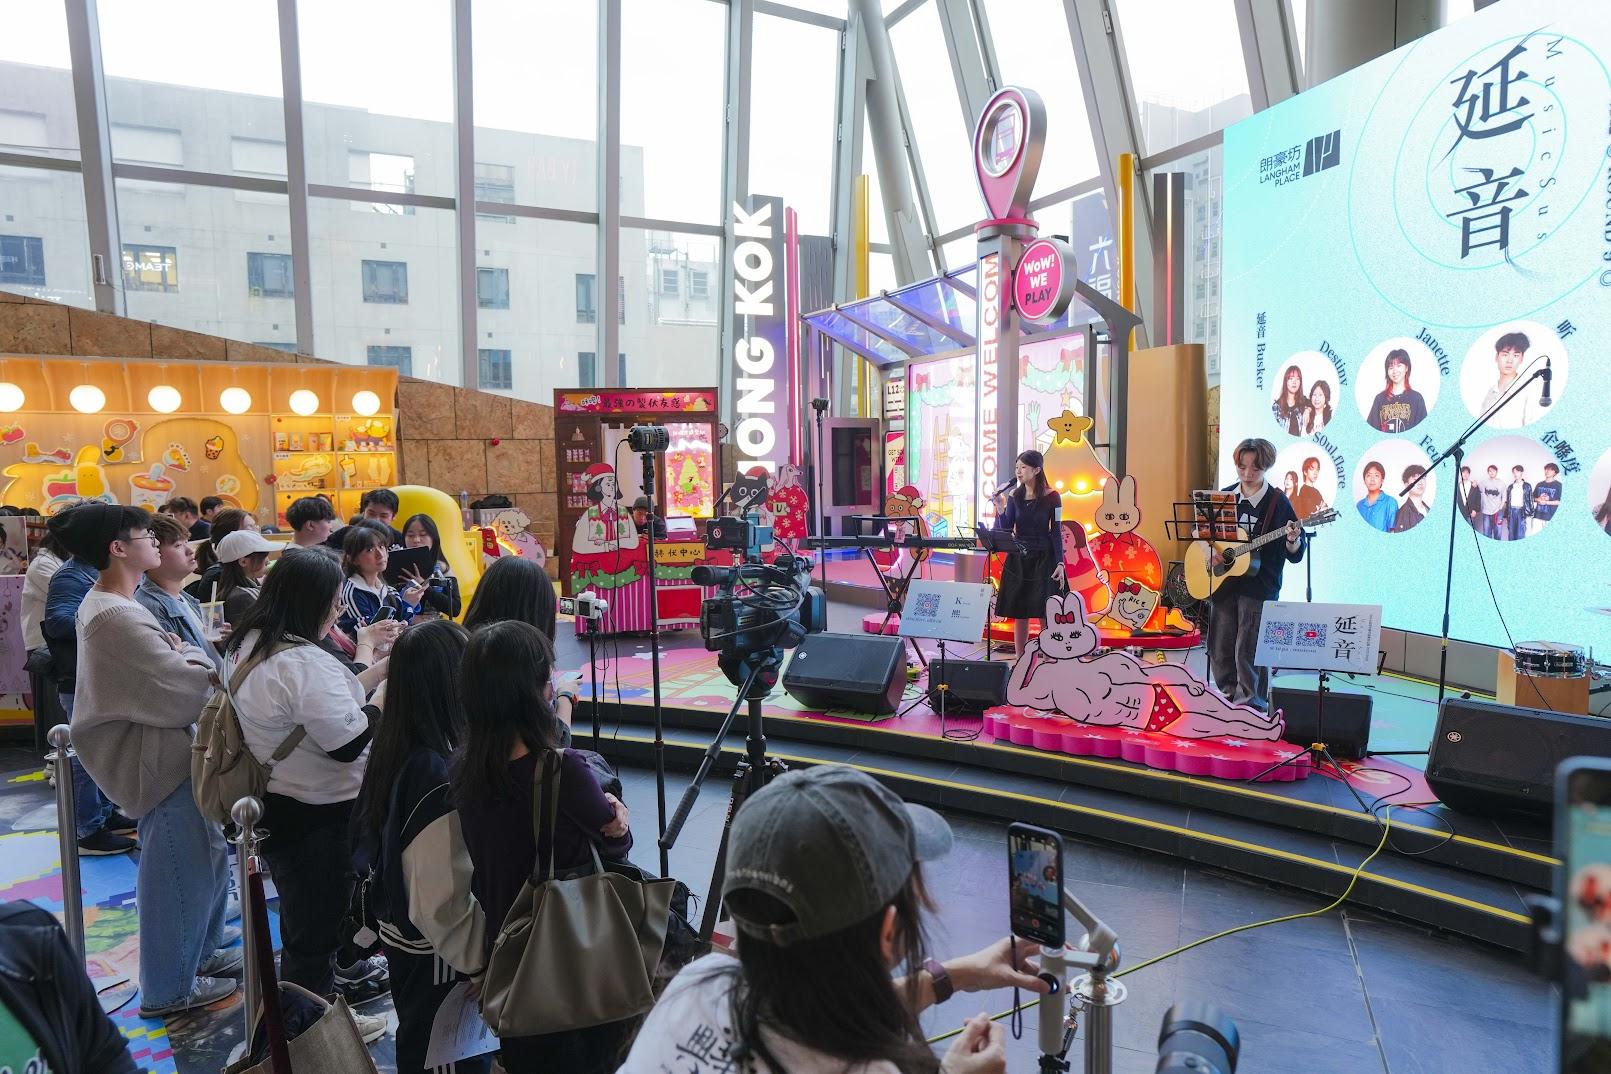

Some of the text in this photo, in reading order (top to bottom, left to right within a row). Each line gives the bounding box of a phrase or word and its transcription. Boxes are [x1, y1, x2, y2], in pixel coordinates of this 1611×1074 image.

[1259, 145, 1302, 173] 朗豪坊
[1437, 32, 1540, 264] 延音
[1259, 162, 1301, 184] LANGHAM
[1274, 171, 1301, 187] PLACE
[733, 200, 774, 316] KOK
[1029, 272, 1048, 289] WE
[1025, 287, 1052, 305] PLAY
[1319, 340, 1348, 387] Destiny
[1415, 326, 1450, 377] Janette
[1256, 343, 1266, 391] Busker
[776, 503, 783, 513] U
[1128, 596, 1147, 607] RICE
[1331, 615, 1358, 663] 延音
